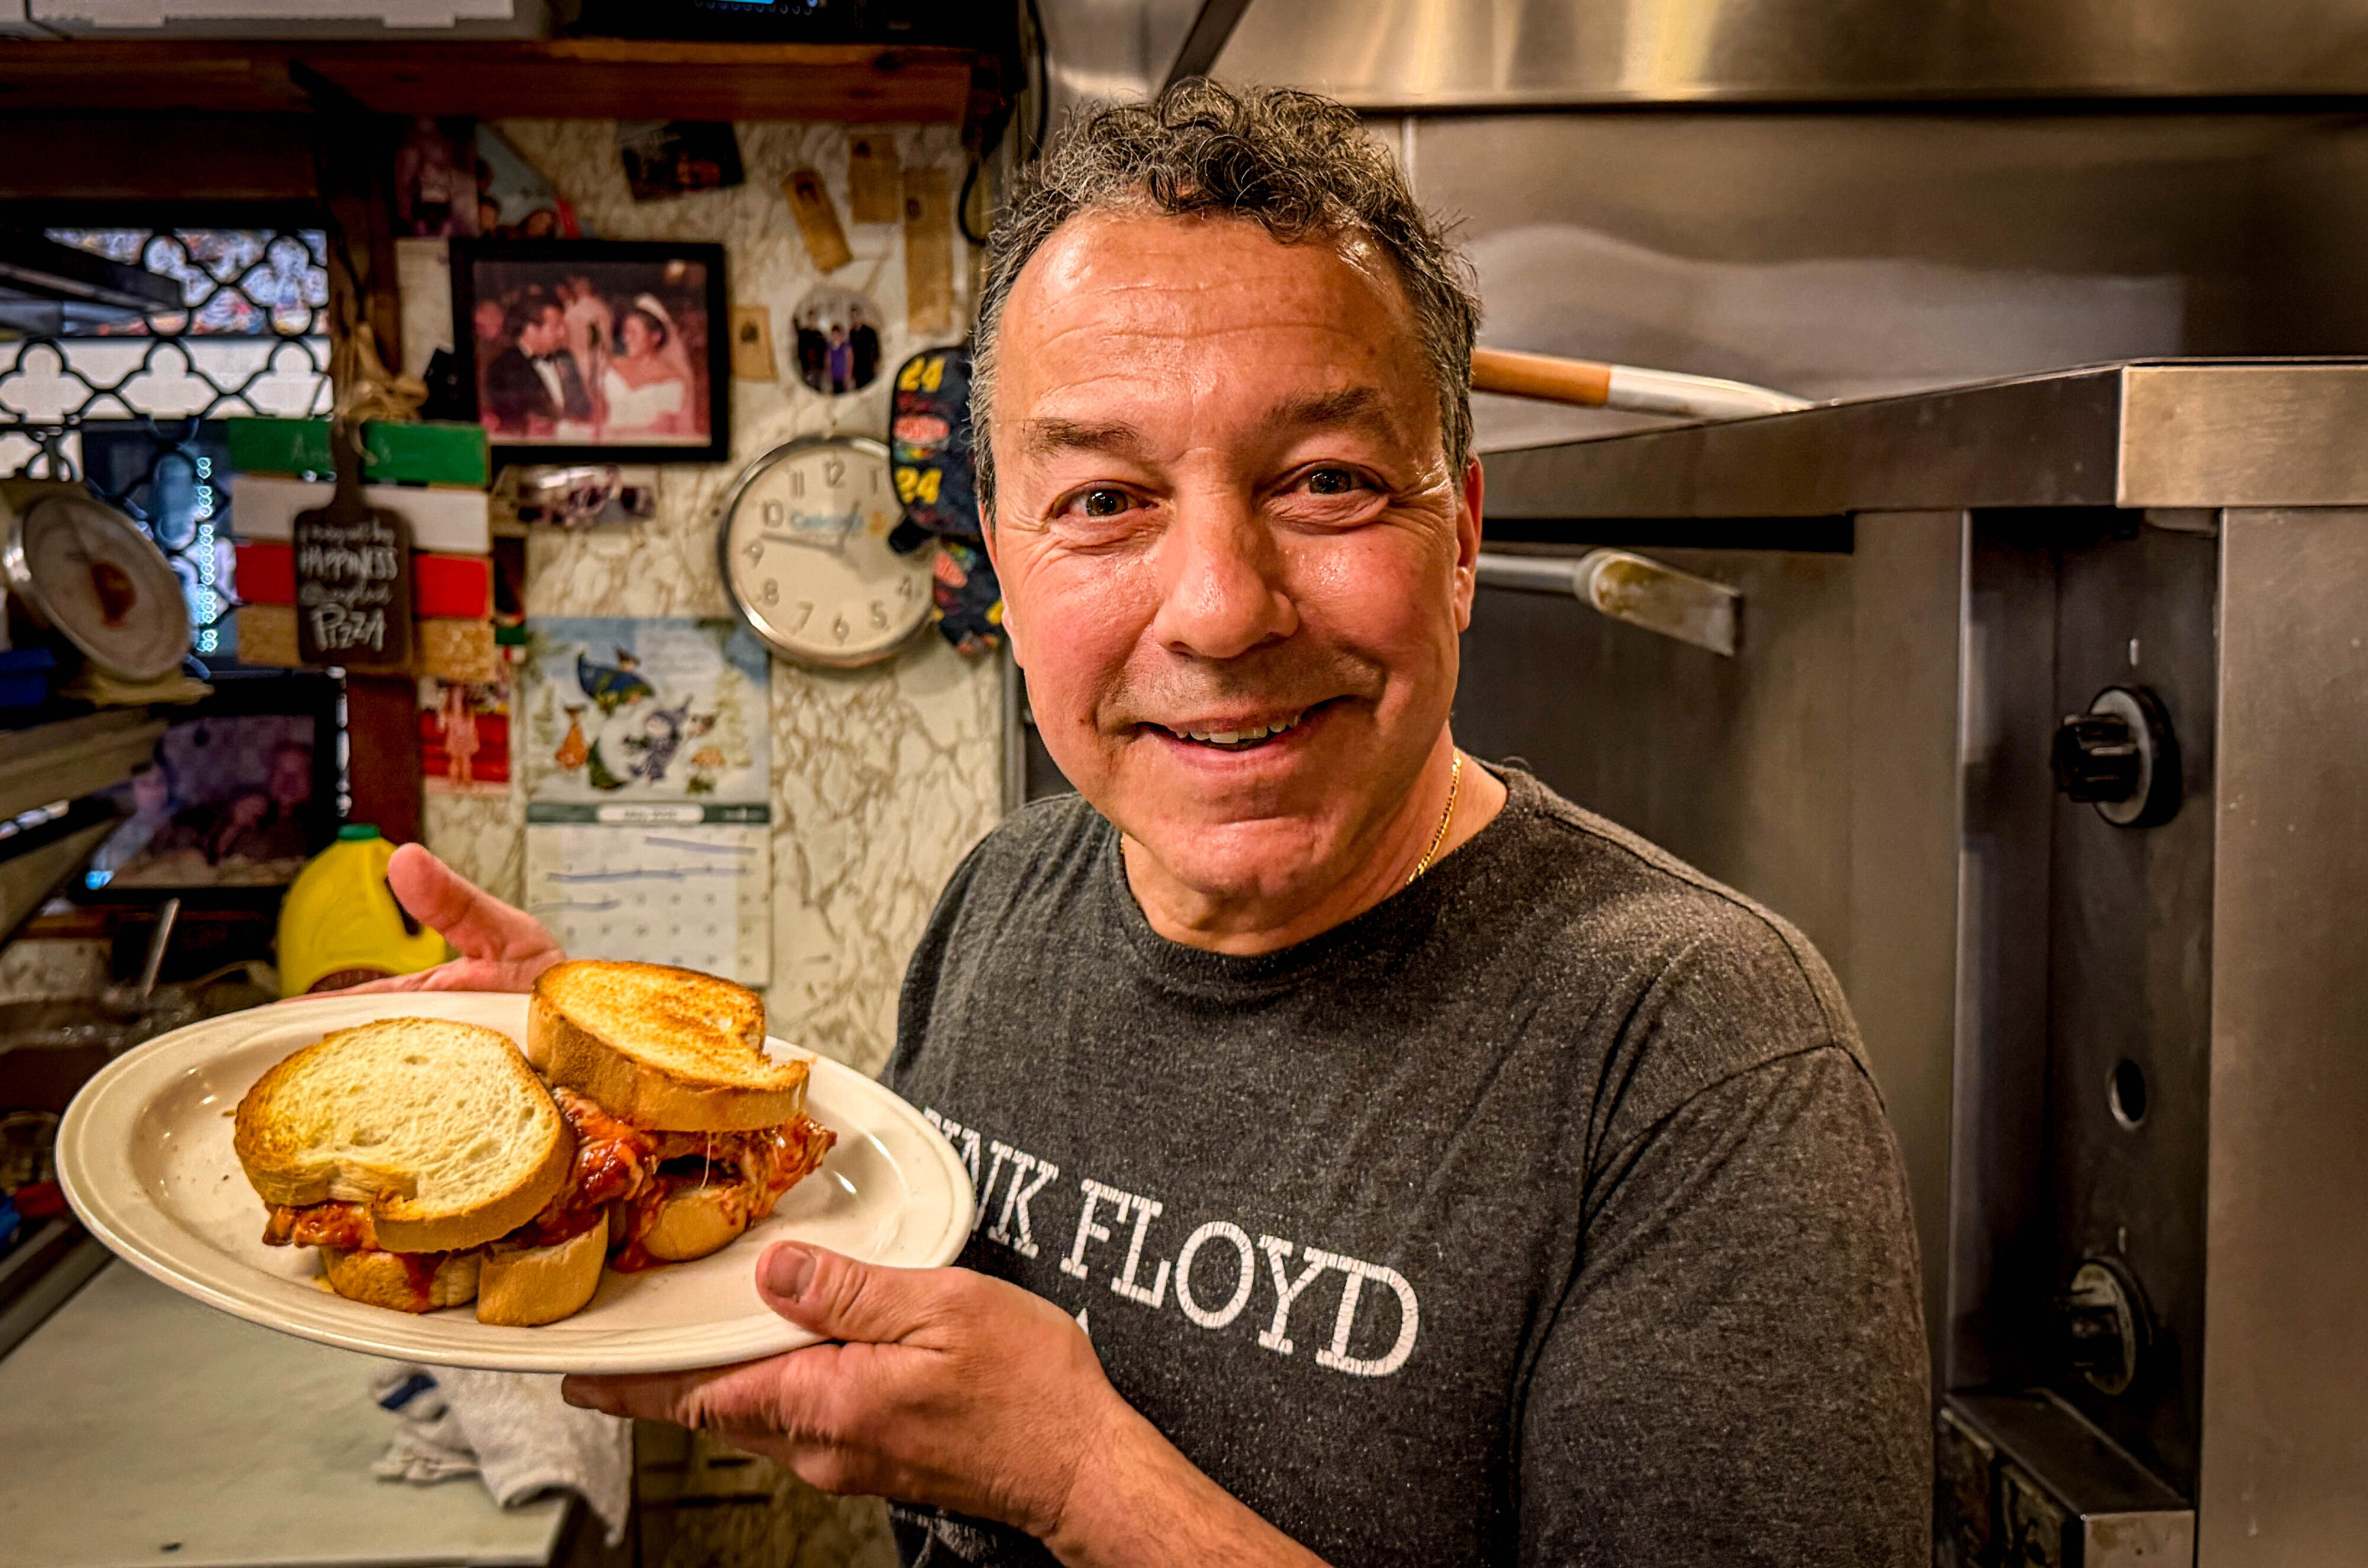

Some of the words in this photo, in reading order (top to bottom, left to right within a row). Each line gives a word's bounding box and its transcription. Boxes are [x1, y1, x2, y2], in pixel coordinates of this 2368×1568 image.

[898, 356, 945, 393] 24
[896, 466, 942, 504] 24
[762, 498, 784, 528] 10
[744, 539, 765, 568] 9
[762, 578, 780, 607] 8
[792, 600, 815, 635] 7
[832, 612, 850, 646] 6
[924, 1106, 1060, 1259] NK
[1060, 1179, 1419, 1377] FLOYD
